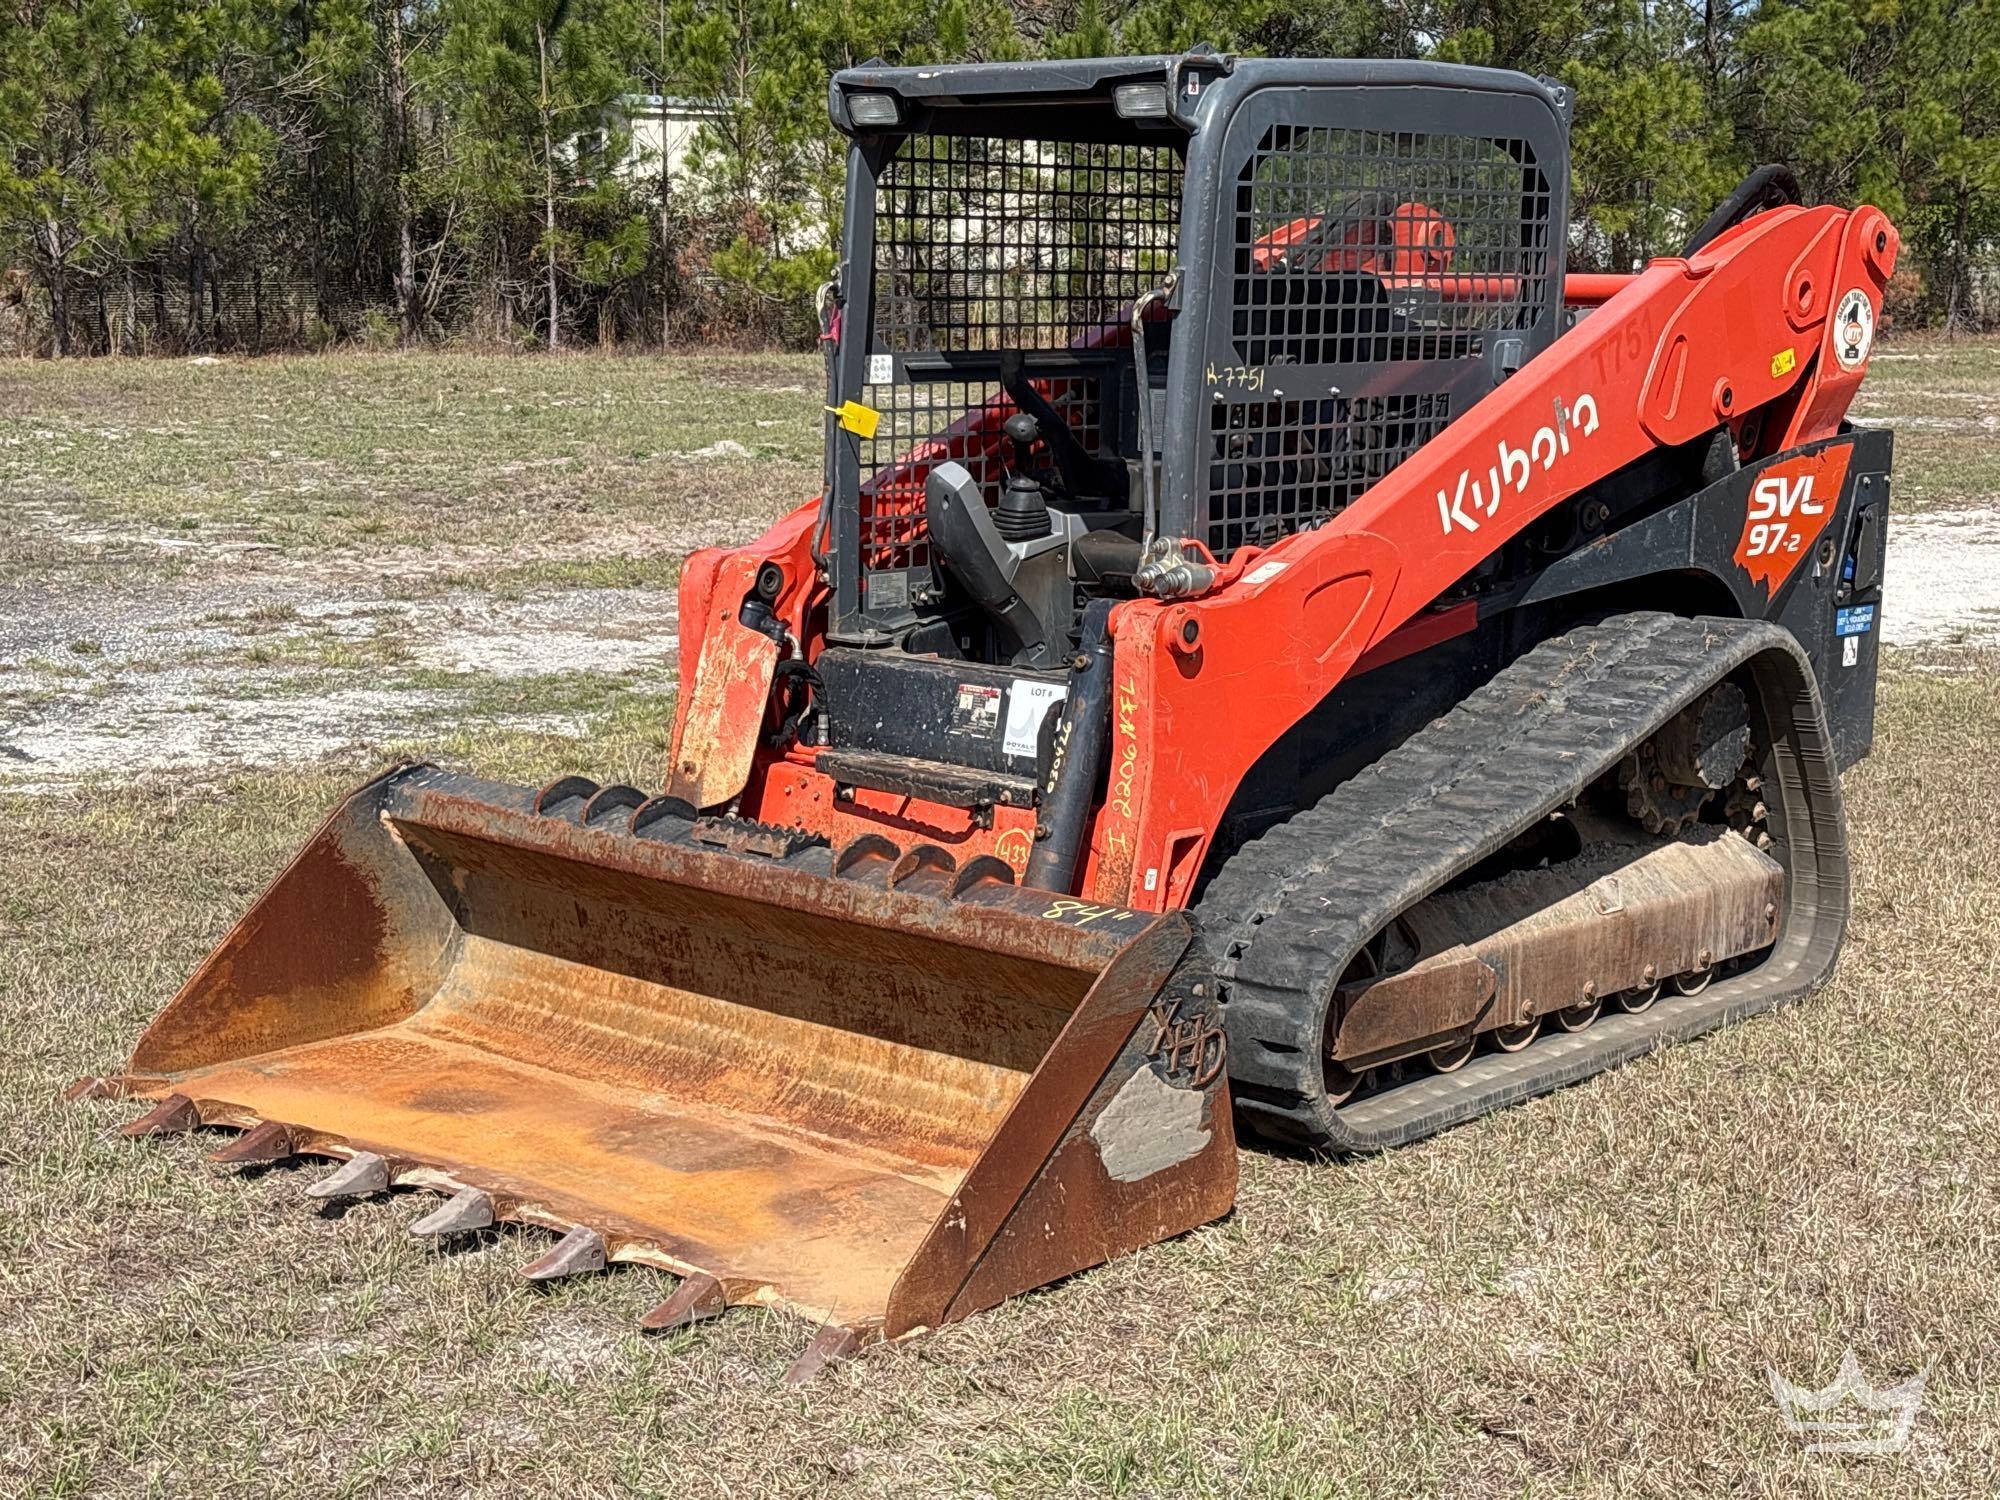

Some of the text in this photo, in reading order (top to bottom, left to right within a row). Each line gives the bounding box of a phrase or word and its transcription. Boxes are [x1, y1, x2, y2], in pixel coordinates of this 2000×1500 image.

[1206, 361, 1265, 392] K-7751
[1436, 394, 1600, 536] Kubota
[1748, 475, 1825, 521] SVL
[1030, 687, 1047, 697] LOT
[1000, 844, 1028, 864] 433
